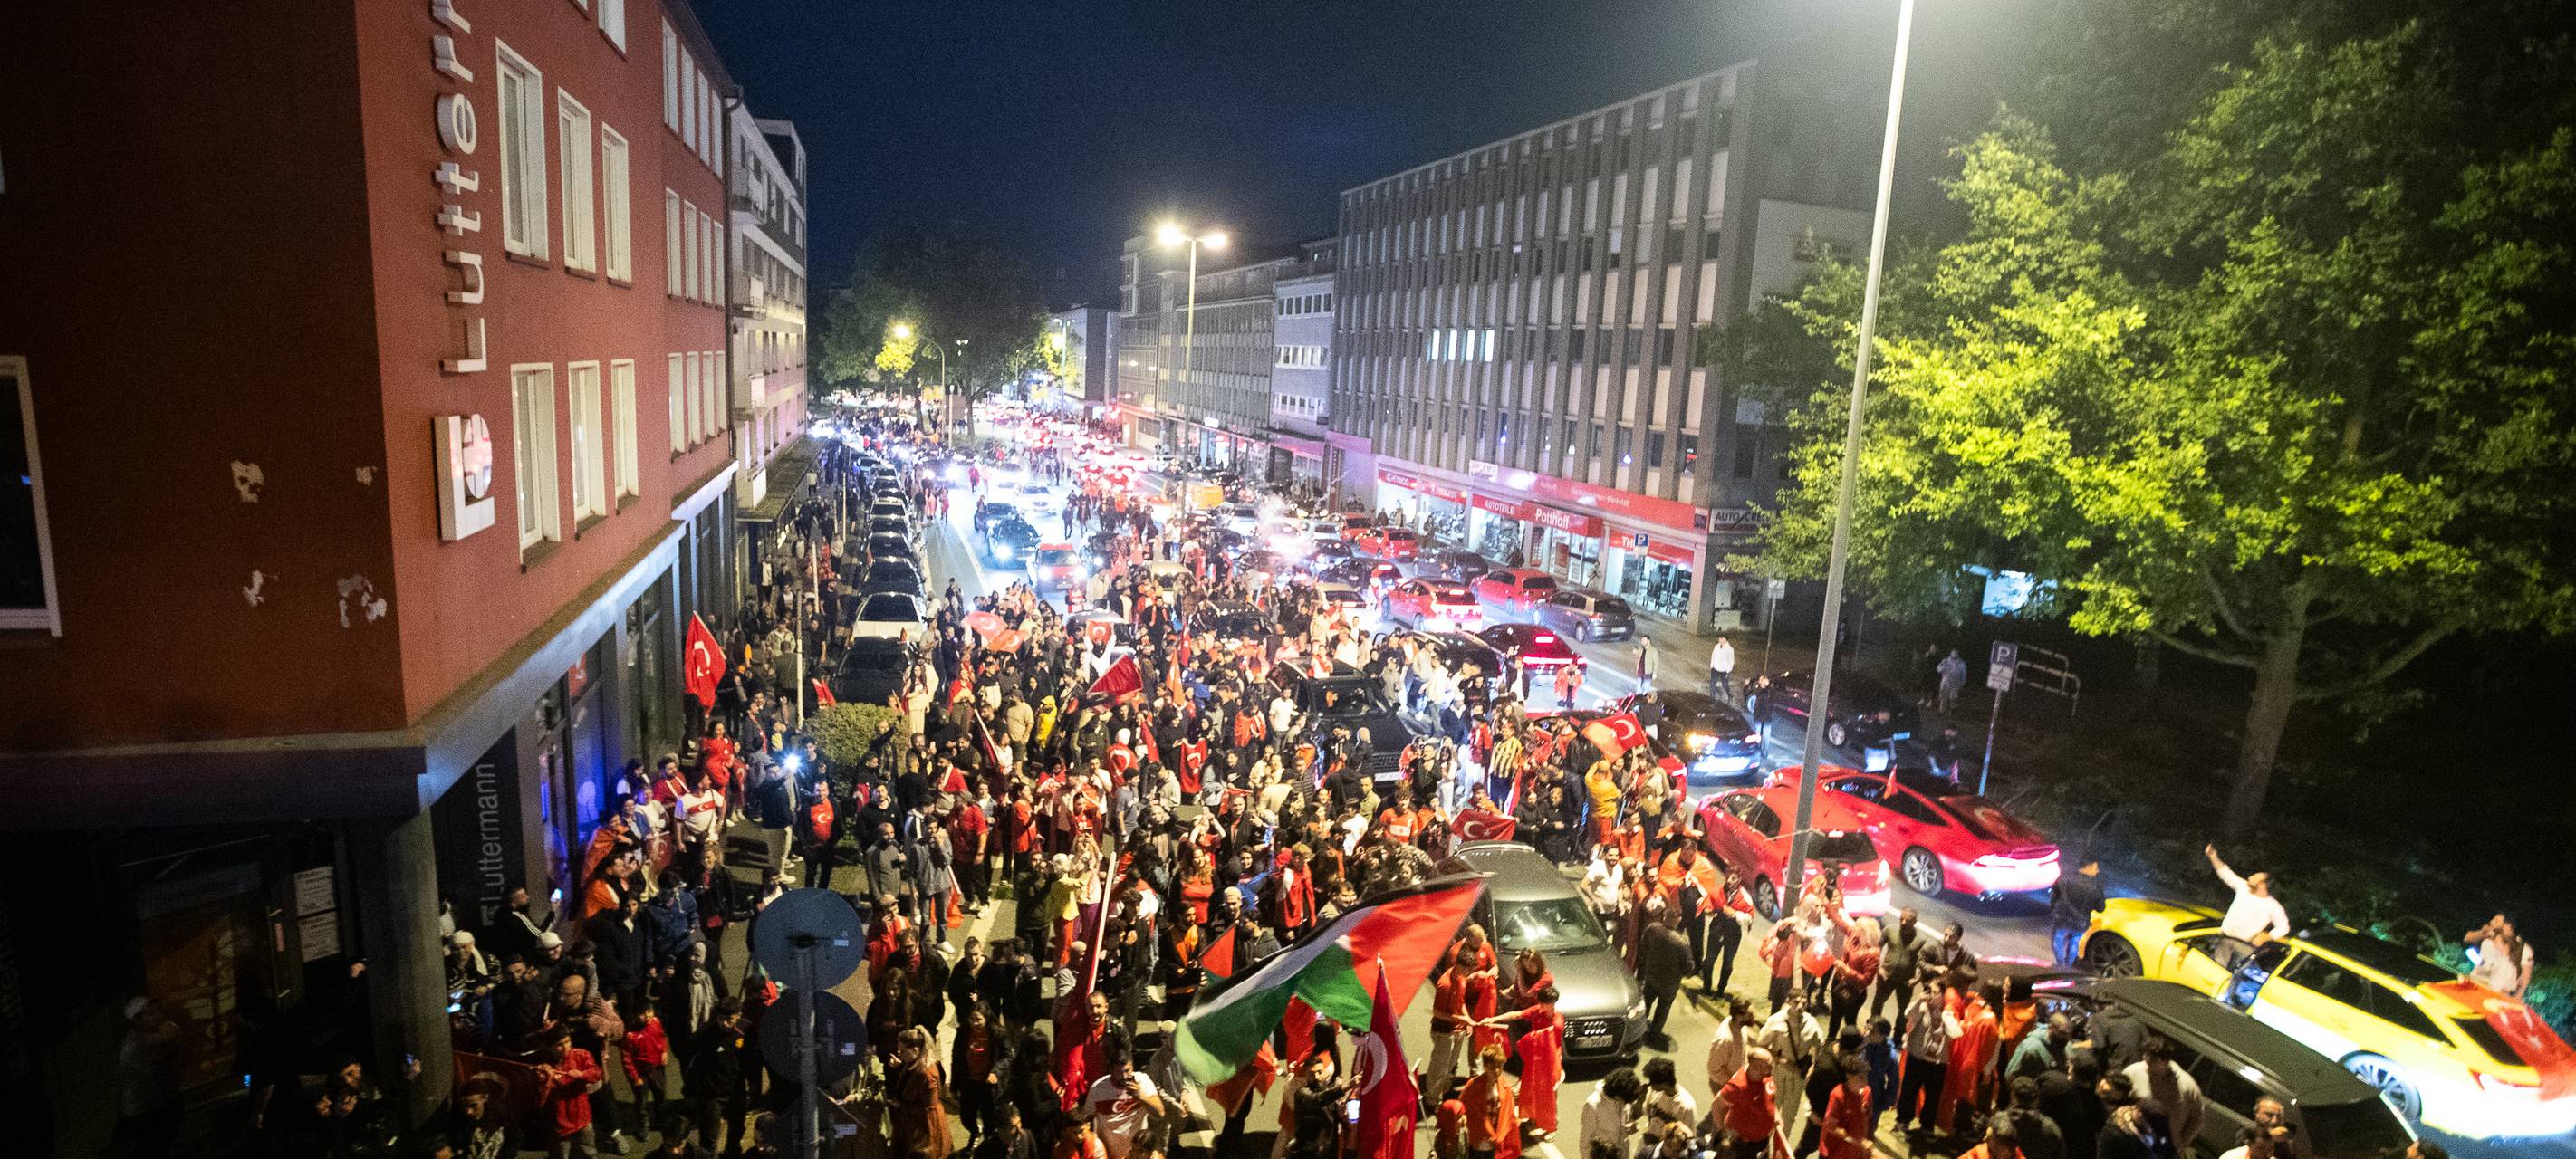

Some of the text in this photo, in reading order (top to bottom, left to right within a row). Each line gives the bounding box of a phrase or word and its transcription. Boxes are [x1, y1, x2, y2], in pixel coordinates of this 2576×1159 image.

[1485, 498, 1514, 514] AUTOTEILE
[1535, 508, 1571, 529] Potthoff
[1716, 511, 1739, 522] AUTO
[1638, 534, 1646, 545] P
[1996, 645, 2010, 663] P
[476, 763, 505, 901] Luttermann
